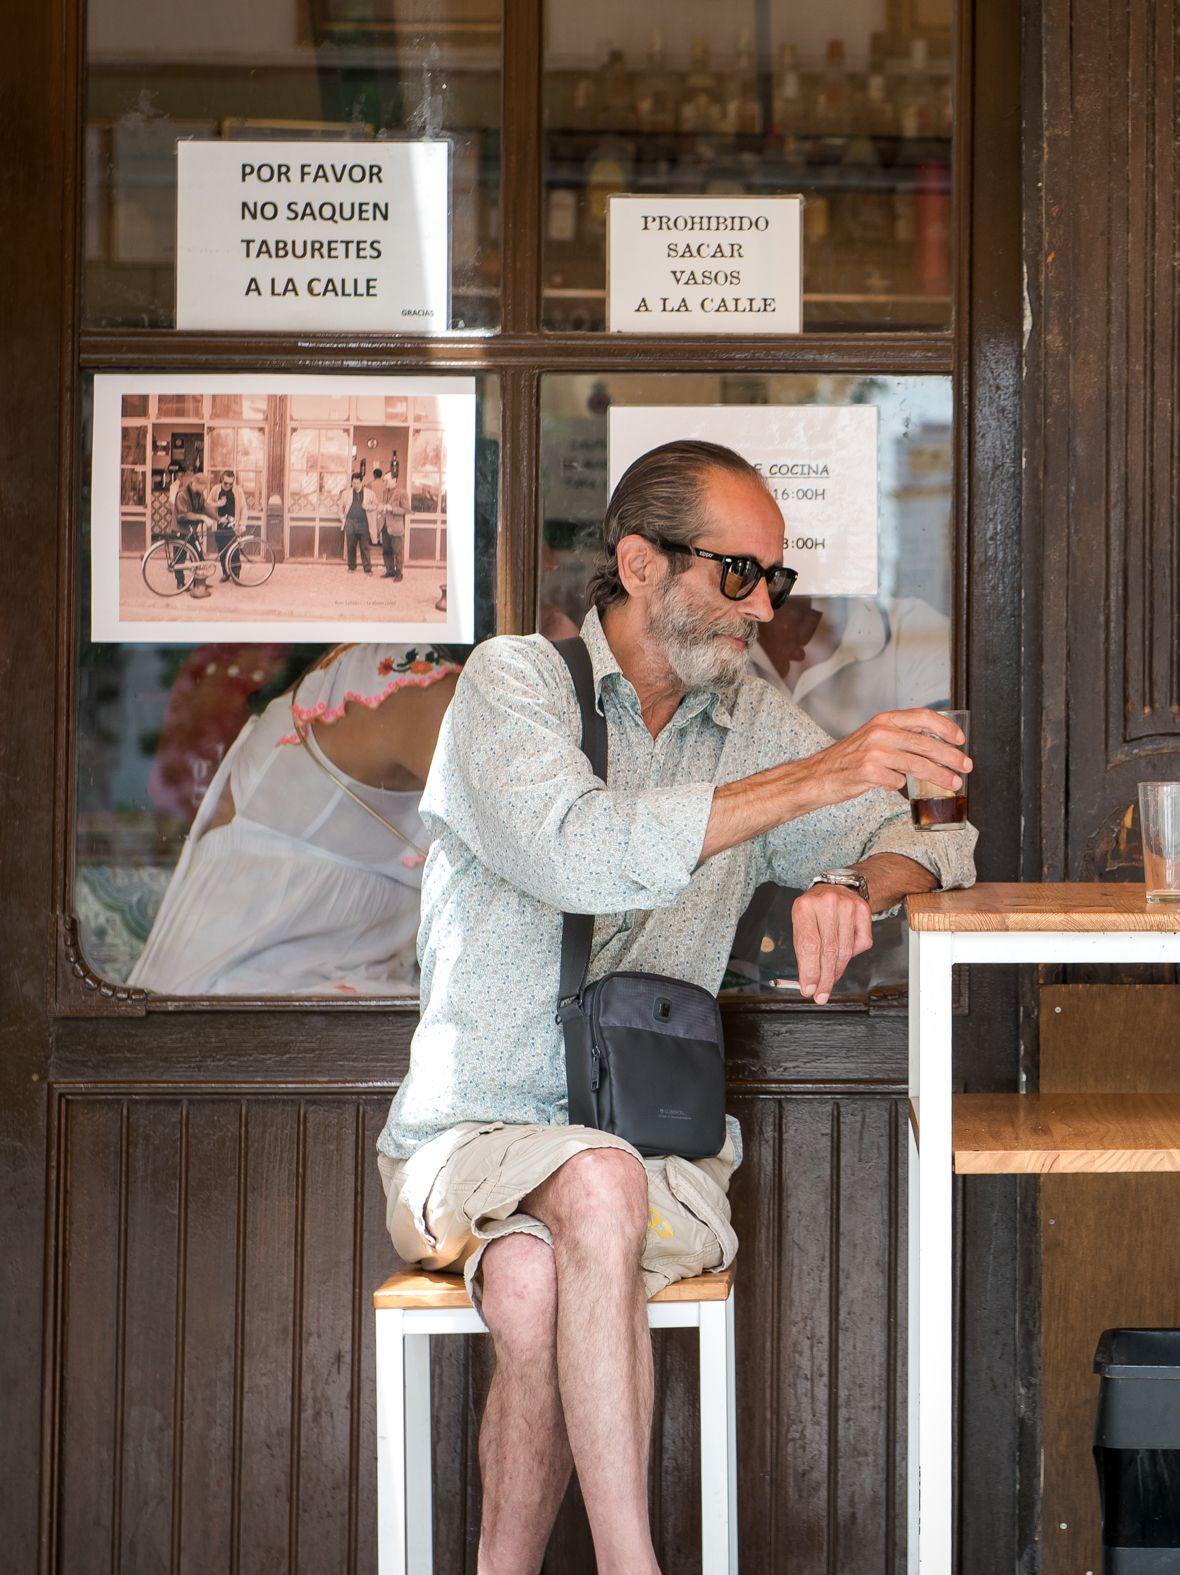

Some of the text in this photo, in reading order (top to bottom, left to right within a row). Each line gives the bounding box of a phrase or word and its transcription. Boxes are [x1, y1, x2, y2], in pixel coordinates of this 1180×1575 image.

[242, 163, 382, 183] POR FAVOR
[242, 201, 388, 224] NO SAQUEN
[641, 216, 769, 231] PROHIBIDO
[241, 239, 382, 259] TABURETES
[667, 243, 744, 258] SACAR
[670, 270, 741, 286] VASOS
[245, 277, 377, 297] A LA CALLE
[401, 308, 434, 317] GRACIAS
[634, 297, 776, 313] A LA CALLE
[769, 464, 829, 476] COCINA
[774, 488, 825, 501] 16:00H
[783, 537, 825, 551] 3:00H
